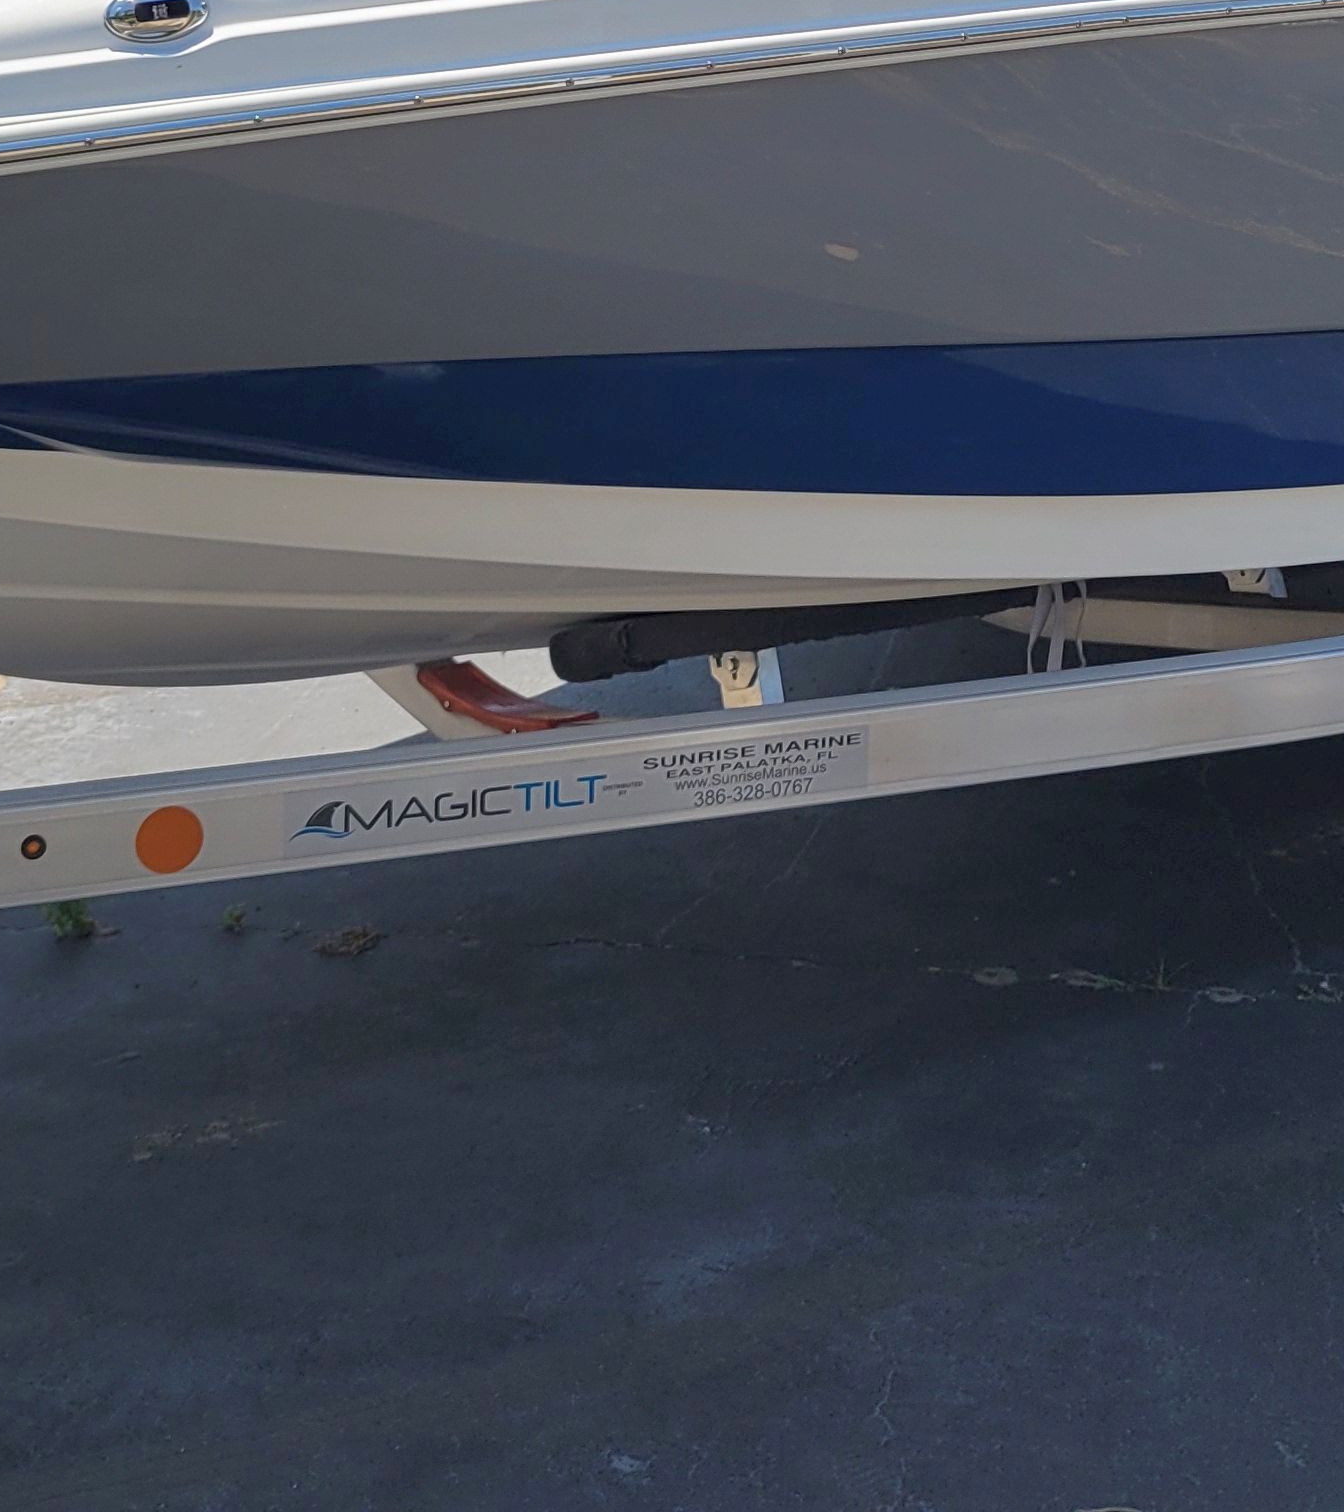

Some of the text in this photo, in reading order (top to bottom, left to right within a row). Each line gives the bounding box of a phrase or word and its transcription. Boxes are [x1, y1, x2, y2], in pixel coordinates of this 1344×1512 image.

[643, 733, 861, 770] SUNRISE MARINE
[666, 750, 838, 779] EAST PALATKA, FL
[675, 762, 828, 792] www.SunriseMarine.us
[694, 778, 814, 808] 386-328-0767
